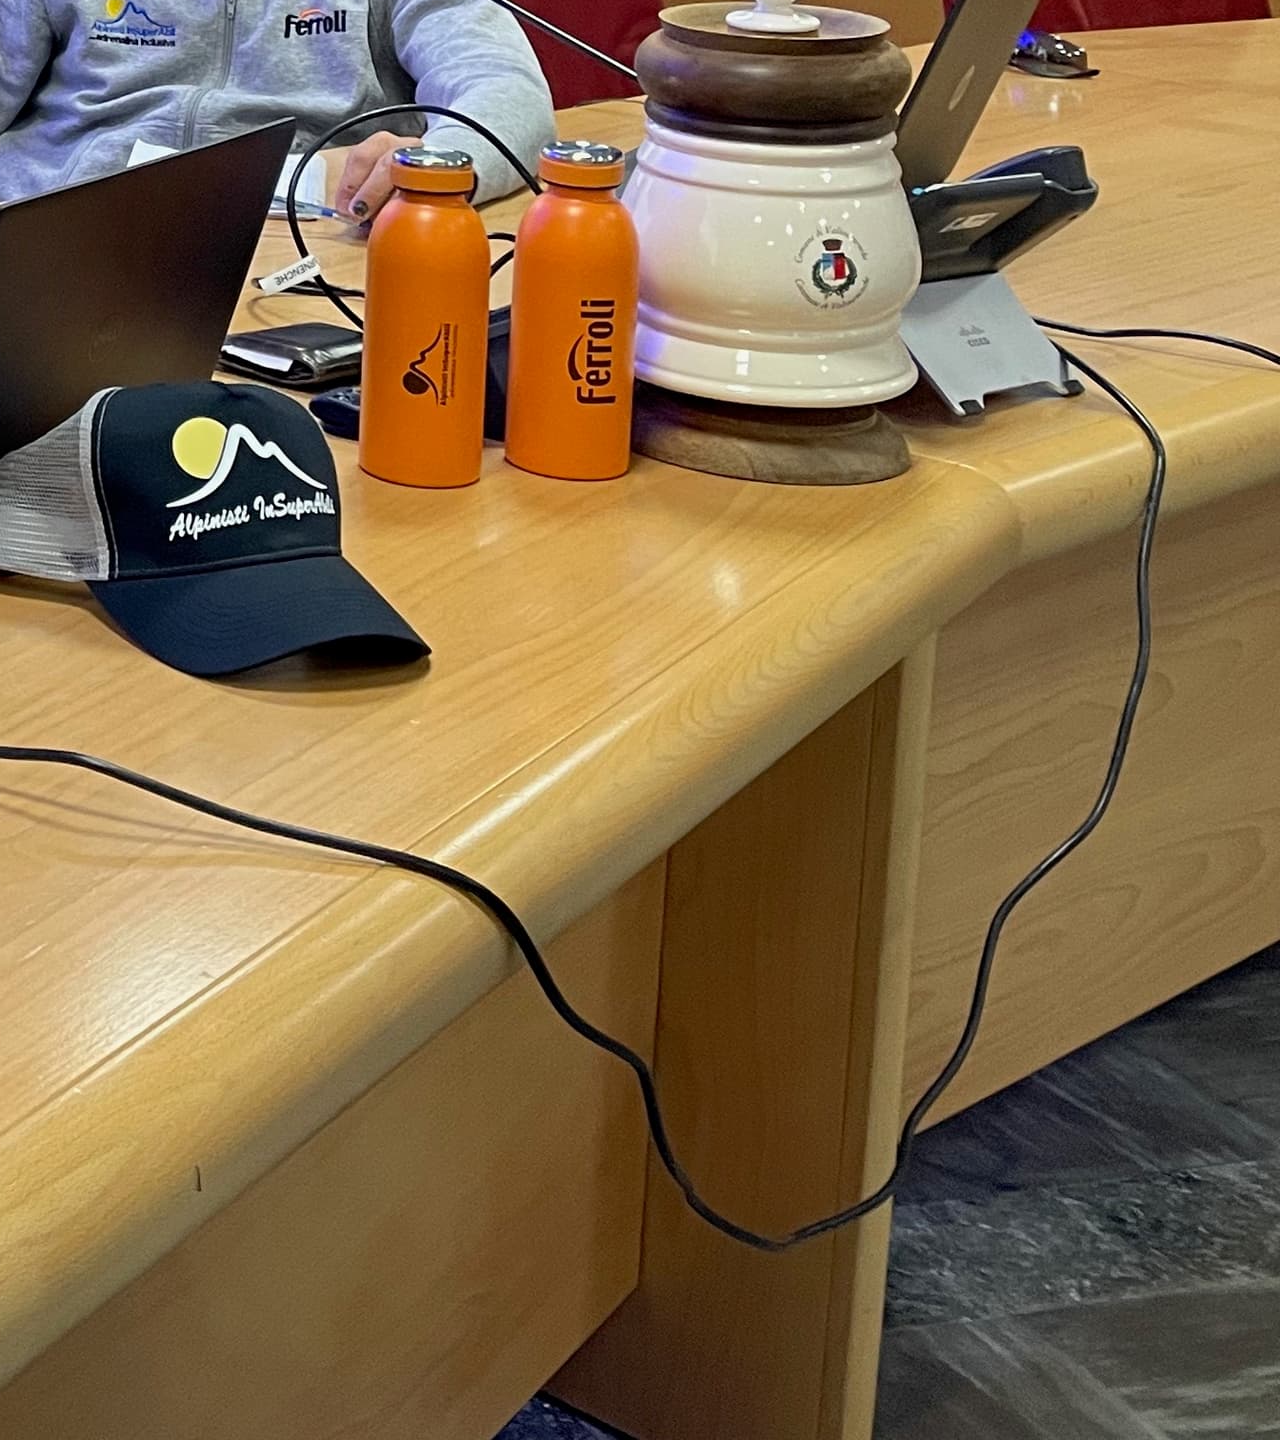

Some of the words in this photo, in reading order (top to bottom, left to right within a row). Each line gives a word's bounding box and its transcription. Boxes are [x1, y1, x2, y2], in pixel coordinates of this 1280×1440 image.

[284, 9, 347, 39] Ferroli
[577, 299, 617, 405] Ferroli
[168, 504, 251, 542] Alpinisti
